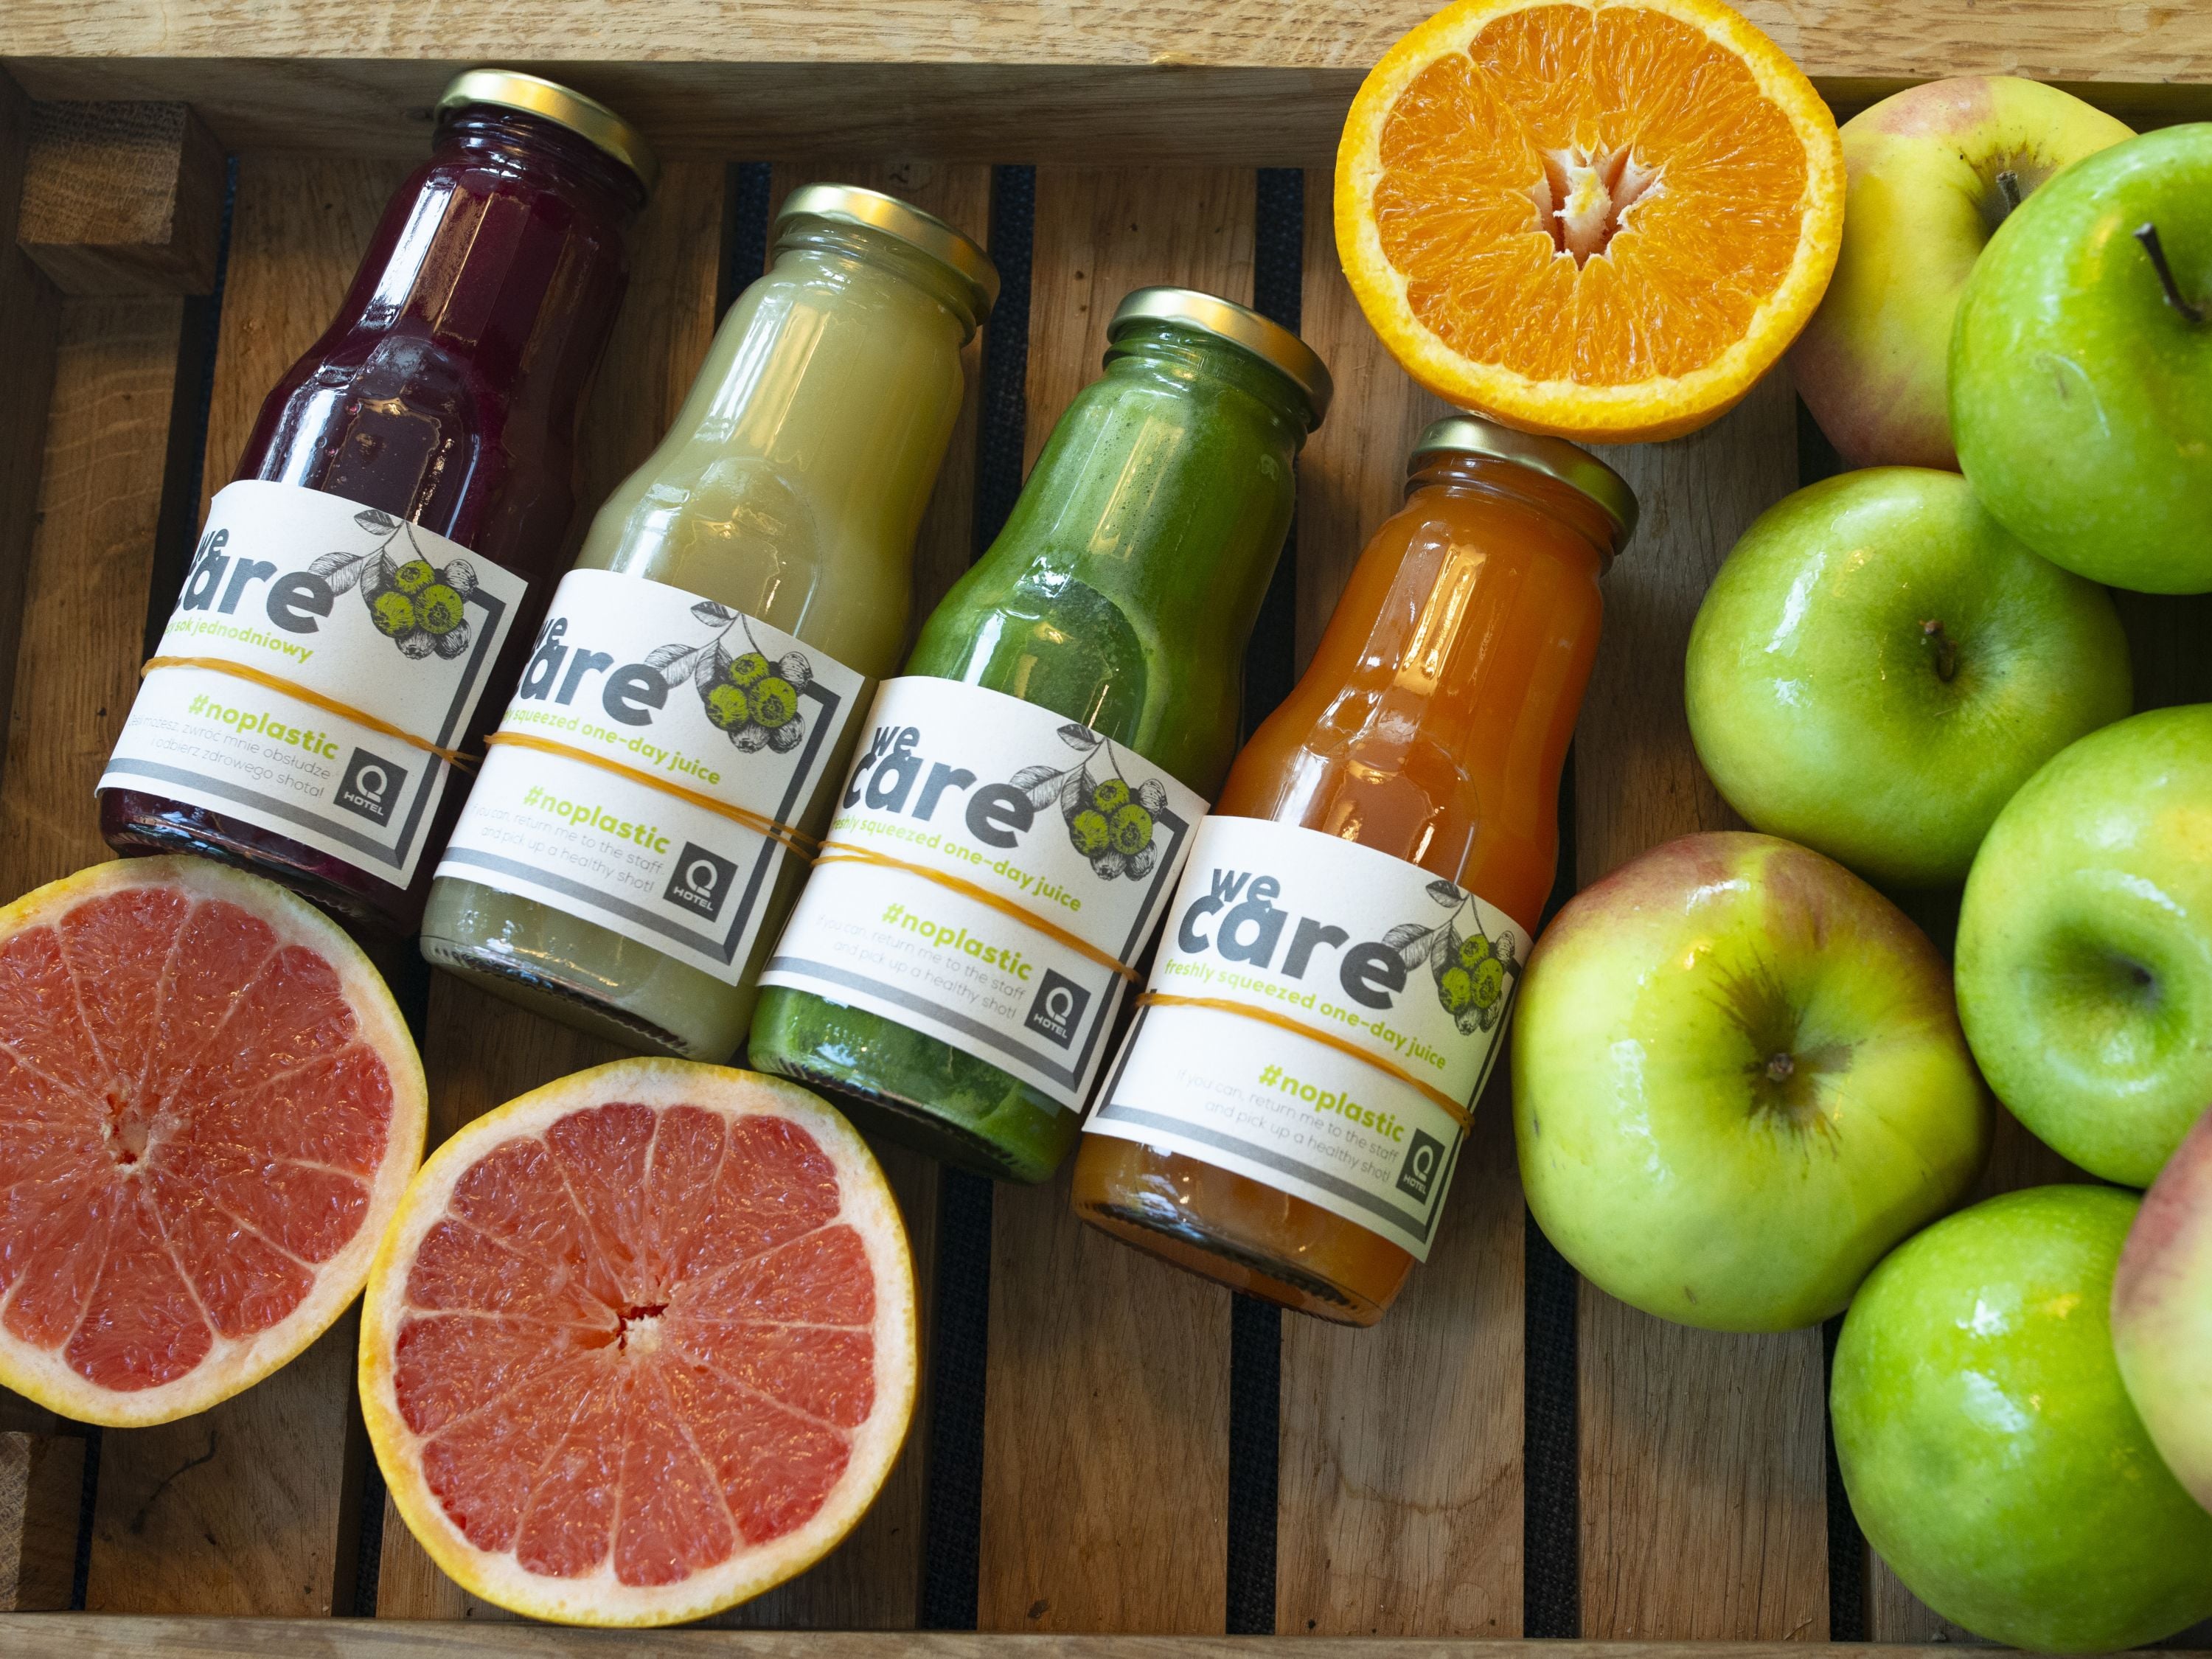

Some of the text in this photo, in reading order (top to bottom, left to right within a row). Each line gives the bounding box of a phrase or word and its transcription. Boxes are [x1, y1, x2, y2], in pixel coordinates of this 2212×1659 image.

[173, 556, 334, 634] are
[191, 618, 314, 664] jednodniowy
[516, 644, 668, 726] are
[182, 723, 221, 742] zwróć
[223, 735, 260, 754] mnie
[263, 746, 331, 779] obsłudze
[188, 694, 339, 760] #noplastic
[513, 709, 580, 731] squeezed
[581, 723, 669, 765] one-day
[667, 751, 720, 785] juice
[871, 726, 920, 757] we
[156, 738, 201, 757] odbierz
[201, 750, 274, 780] zdrowego
[276, 774, 324, 799] shota!
[344, 791, 385, 816] HOTEL
[843, 751, 1034, 849] care
[513, 813, 552, 832] return
[554, 827, 577, 842] me
[581, 835, 597, 849] to
[599, 838, 623, 858] the
[523, 785, 671, 855] #noplastic
[528, 841, 545, 853] up
[548, 846, 558, 856] a
[561, 848, 614, 879] healthy
[617, 870, 654, 892] shot!
[672, 886, 713, 911] HOTEL
[860, 819, 942, 849] squeezed
[944, 841, 1034, 889] one-day
[1032, 876, 1081, 912] juice
[1211, 869, 1281, 902] we
[872, 931, 916, 952] return
[917, 947, 942, 964] me
[945, 954, 961, 971] to
[964, 964, 988, 984] the
[991, 979, 1026, 1001] staff
[881, 902, 1032, 981] #noplastic
[1178, 895, 1407, 1009] care
[833, 941, 860, 956] and
[888, 959, 908, 973] up
[911, 966, 921, 977] a
[924, 969, 980, 1004] healthy
[981, 995, 1017, 1020] shot!
[1164, 959, 1447, 1071] freshly squeezed one-day juice
[1034, 1012, 1068, 1039] HOTEL
[1186, 1074, 1214, 1091] you
[1249, 1093, 1296, 1119] return
[1299, 1113, 1324, 1130] me
[1327, 1121, 1342, 1138] to
[1346, 1130, 1368, 1149] the
[1368, 1142, 1399, 1163] staff
[1259, 1064, 1405, 1143] #noplastic
[1204, 1100, 1391, 1183] and pick up a healthy shot!
[1403, 1173, 1427, 1194] HOTEL
